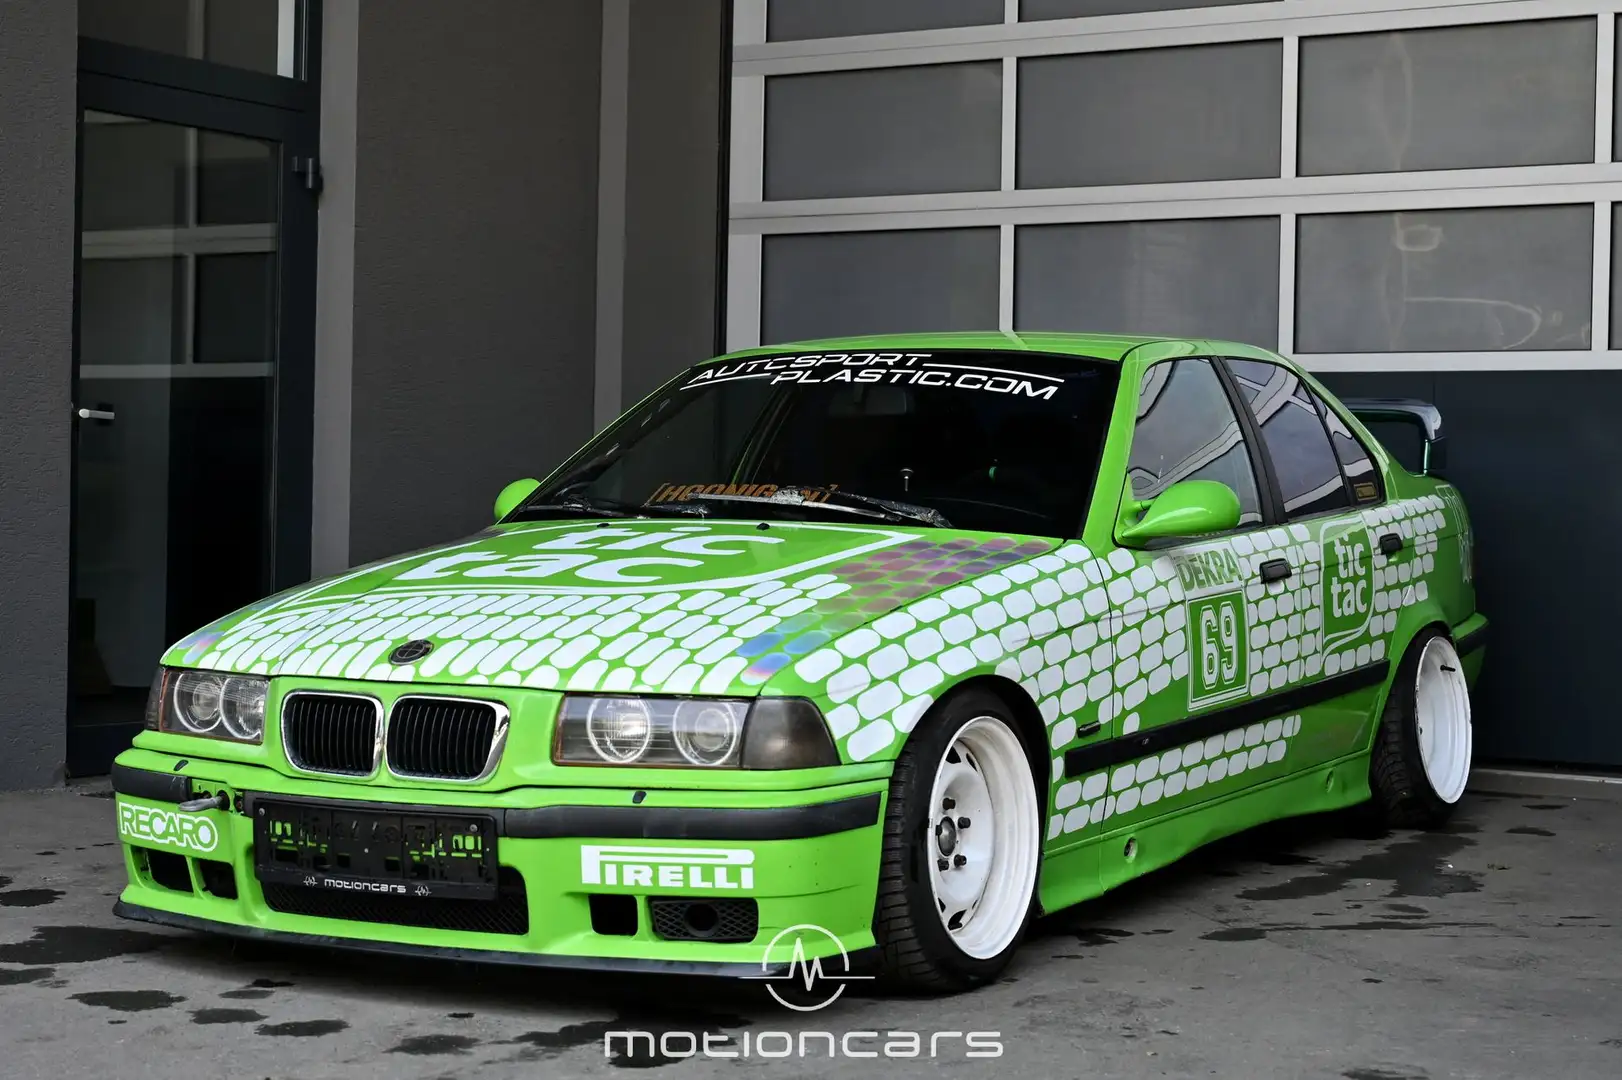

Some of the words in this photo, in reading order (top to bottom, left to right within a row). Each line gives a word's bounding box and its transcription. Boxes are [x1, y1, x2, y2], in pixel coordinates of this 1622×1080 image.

[770, 369, 1059, 400] PLASTIC.COM
[532, 525, 786, 556] tic
[1333, 532, 1367, 581] tic
[393, 551, 705, 583] tac
[1176, 548, 1242, 592] DEKRA
[1330, 576, 1368, 618] tac
[1201, 601, 1238, 690] 69
[119, 802, 218, 852] RECARO
[324, 877, 407, 894] motioncars
[581, 845, 755, 889] PIRELLI
